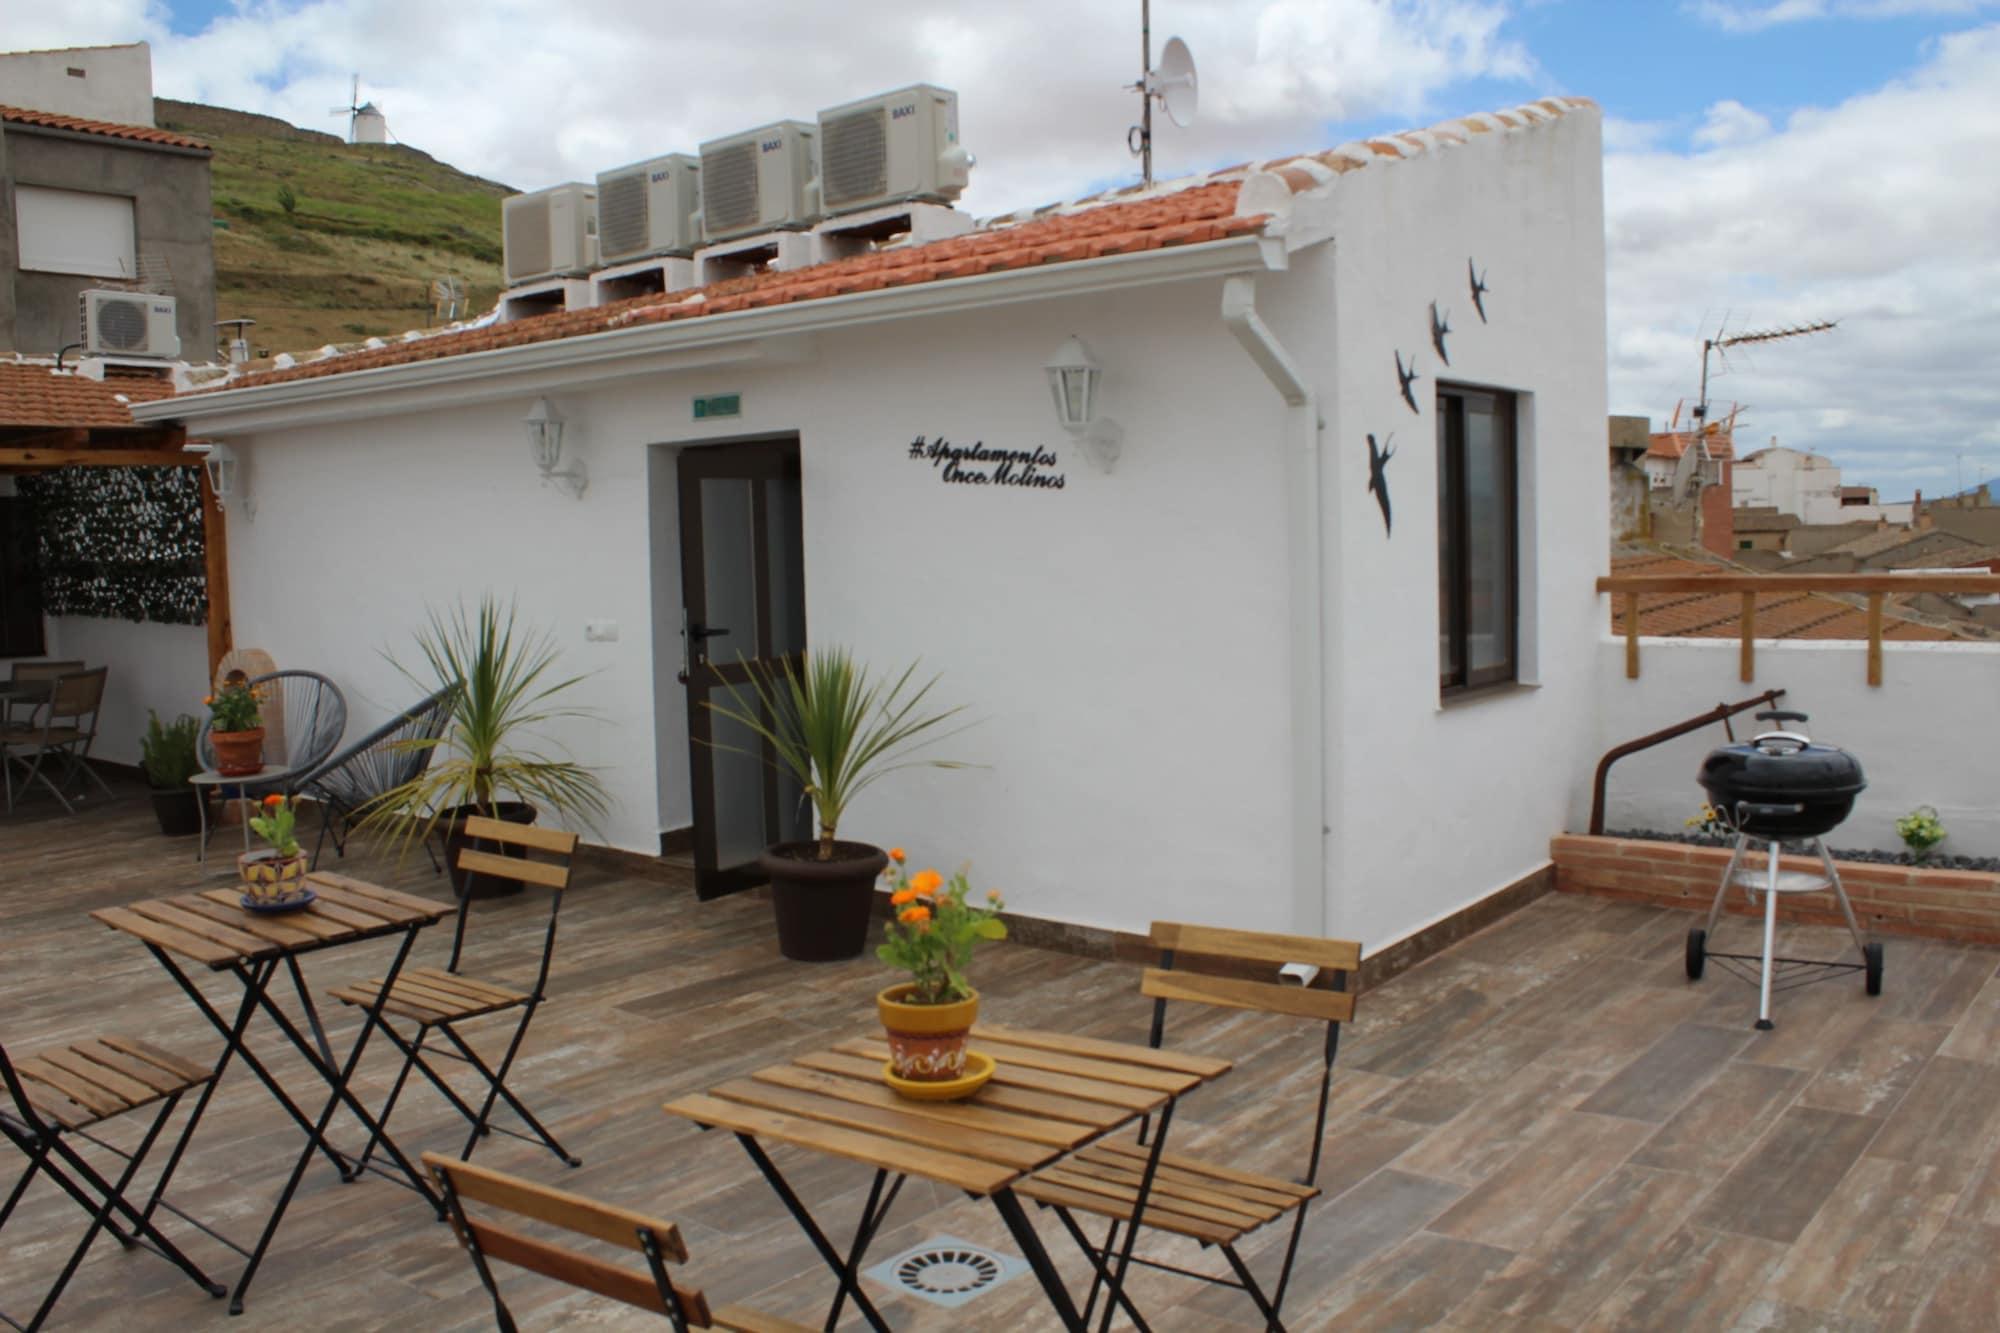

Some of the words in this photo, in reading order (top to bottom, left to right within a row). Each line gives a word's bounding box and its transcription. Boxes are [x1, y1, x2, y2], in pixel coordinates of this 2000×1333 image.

[892, 104, 916, 120] BAXI
[762, 139, 782, 153] BAXI
[652, 171, 670, 183] BAXI
